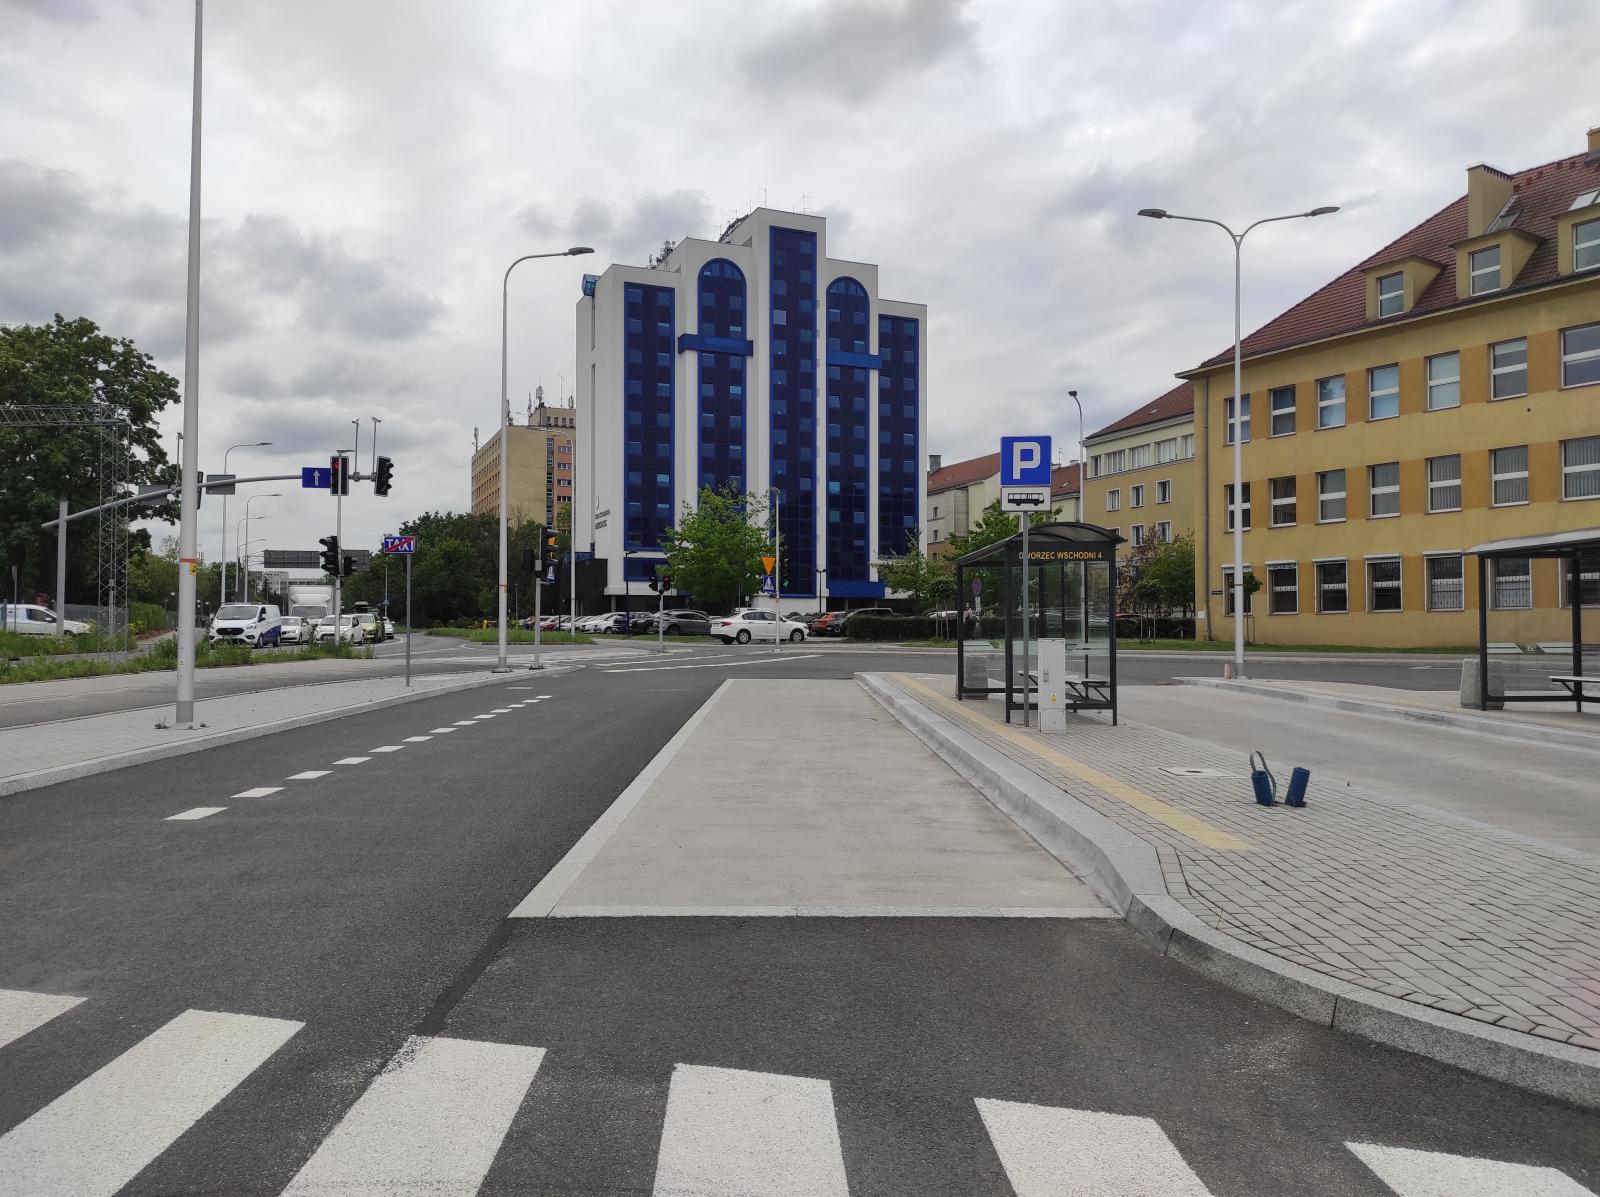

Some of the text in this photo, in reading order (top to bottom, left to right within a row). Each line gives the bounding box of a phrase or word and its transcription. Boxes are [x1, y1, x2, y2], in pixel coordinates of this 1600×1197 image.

[1012, 441, 1041, 480] P
[385, 538, 414, 551] TAXI
[1056, 551, 1096, 560] WSCHODNI
[1097, 551, 1103, 560] 4
